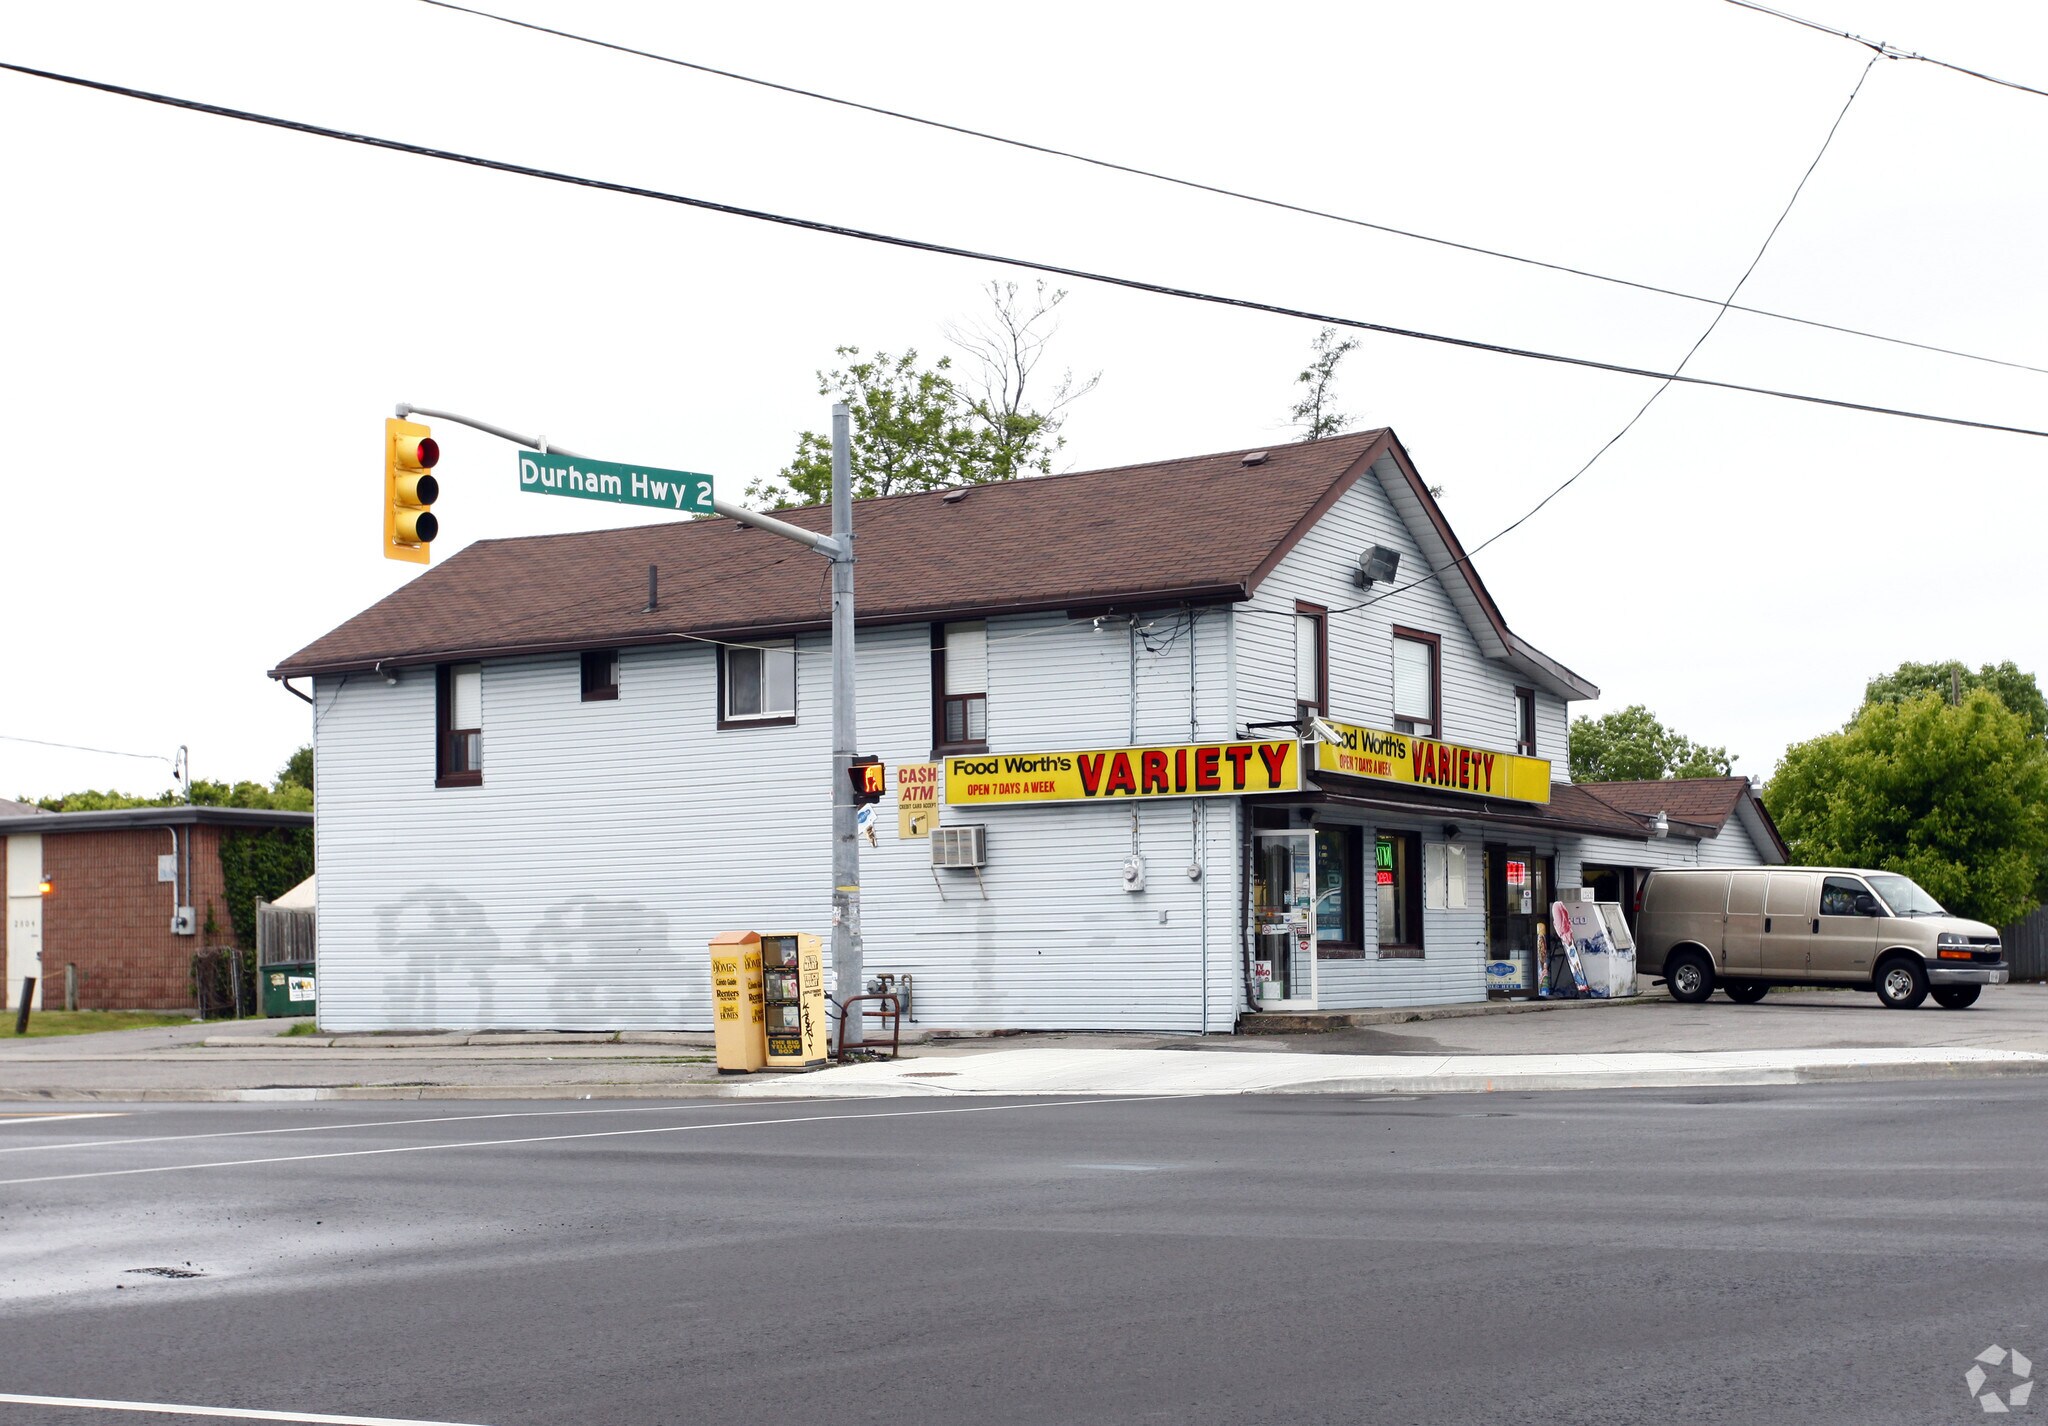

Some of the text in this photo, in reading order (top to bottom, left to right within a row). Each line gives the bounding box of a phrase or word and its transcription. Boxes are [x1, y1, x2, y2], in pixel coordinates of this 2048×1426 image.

[521, 458, 712, 509] Durham Hwy 2
[1361, 730, 1406, 760] Worth's
[953, 756, 1072, 776] Food Worth's
[1076, 743, 1290, 797] VARIETY
[1340, 754, 1392, 776] OPEN 7 DAYS A WEEK
[1412, 740, 1495, 792] VARIETY
[902, 786, 934, 801] ATM
[967, 780, 1056, 796] OPEN 7 DAYS A WEEK
[716, 990, 740, 998] Renters
[720, 1012, 738, 1020] HOMES
